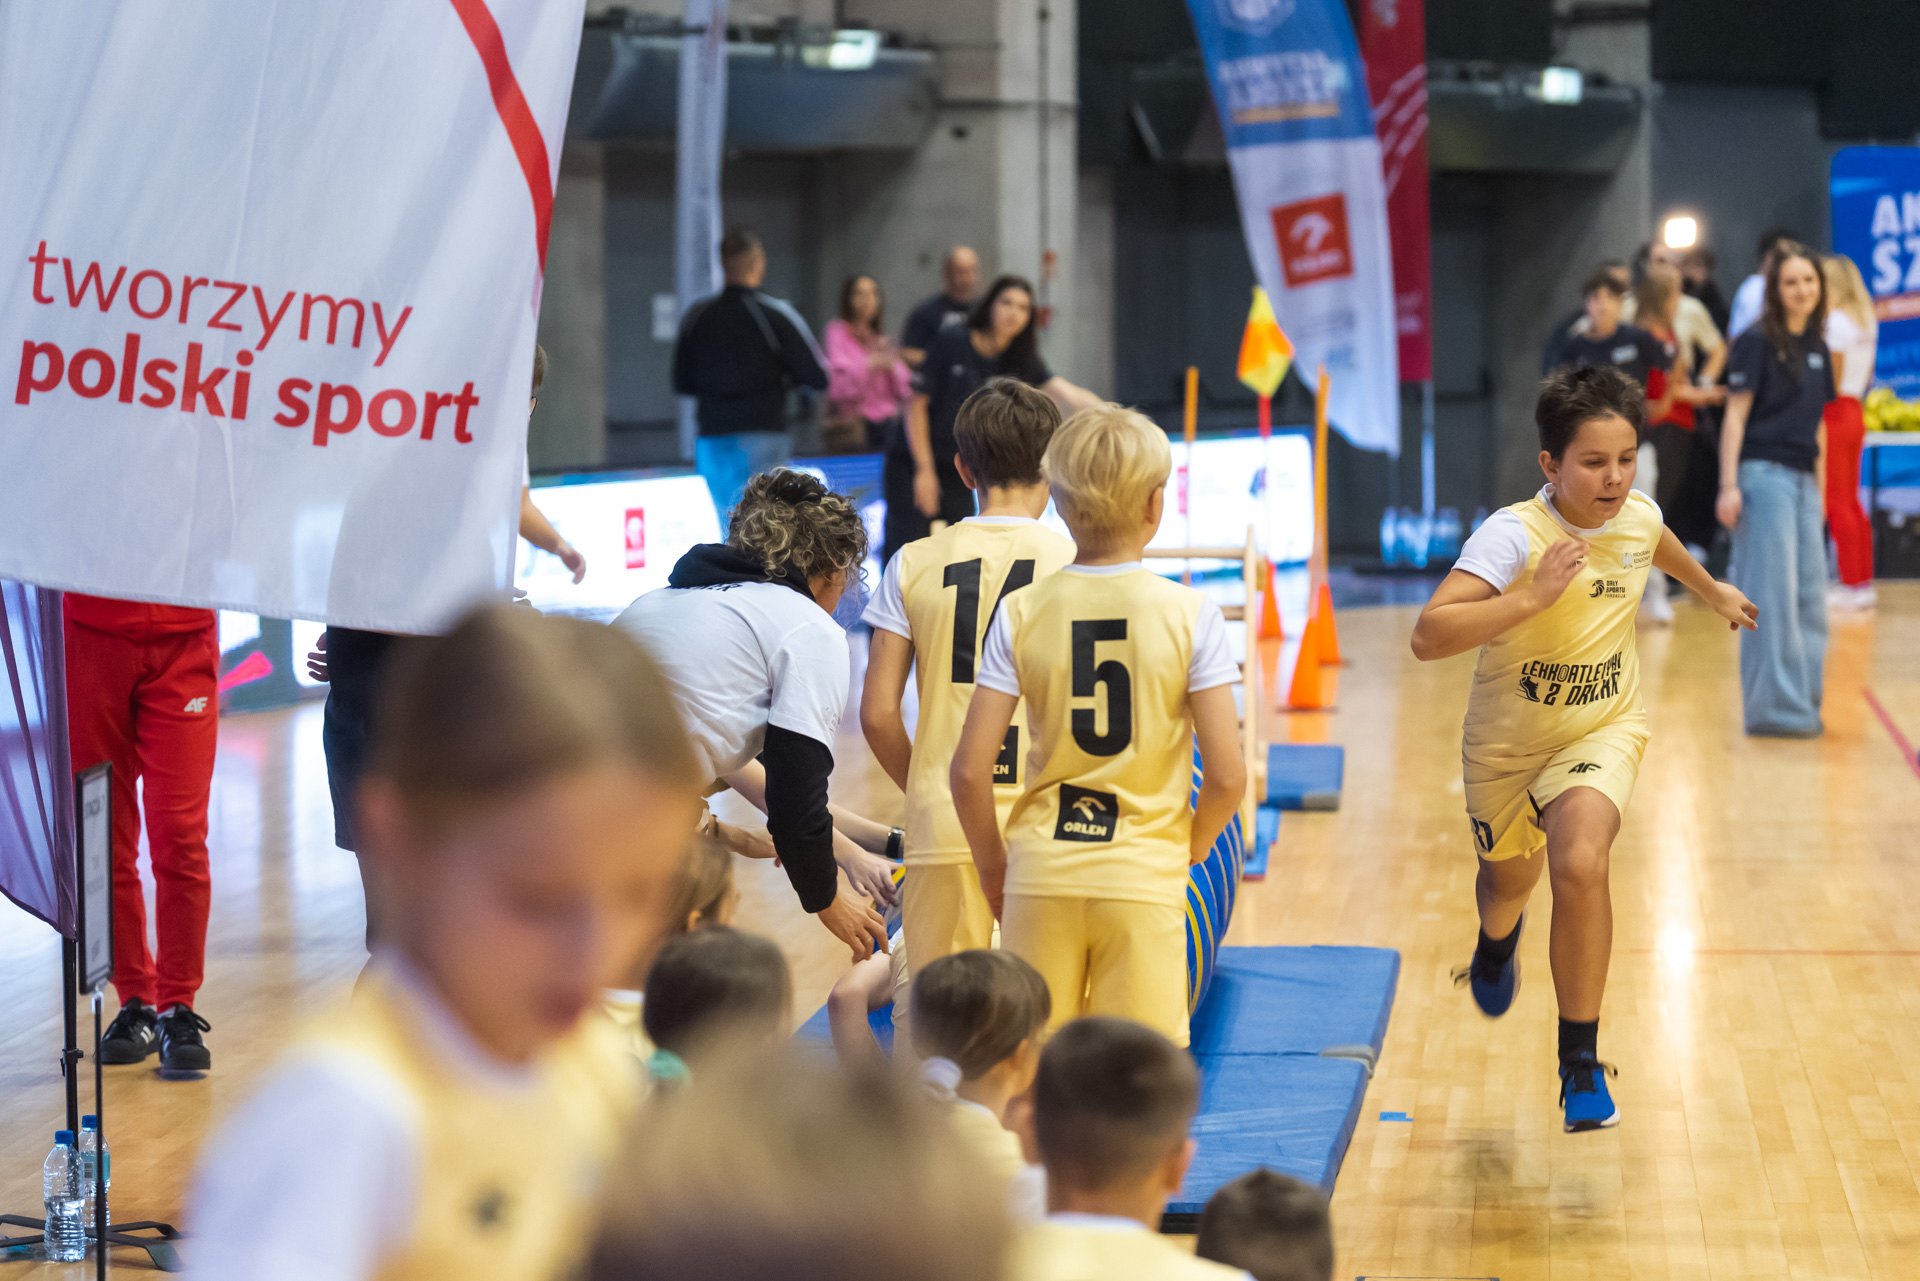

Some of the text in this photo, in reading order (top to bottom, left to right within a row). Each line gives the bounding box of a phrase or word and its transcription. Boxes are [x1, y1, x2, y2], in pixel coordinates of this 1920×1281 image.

[29, 241, 413, 367] tworzymy
[15, 333, 480, 447] polski sport
[1072, 619, 1131, 757] 5
[1063, 821, 1108, 836] ORLEN
